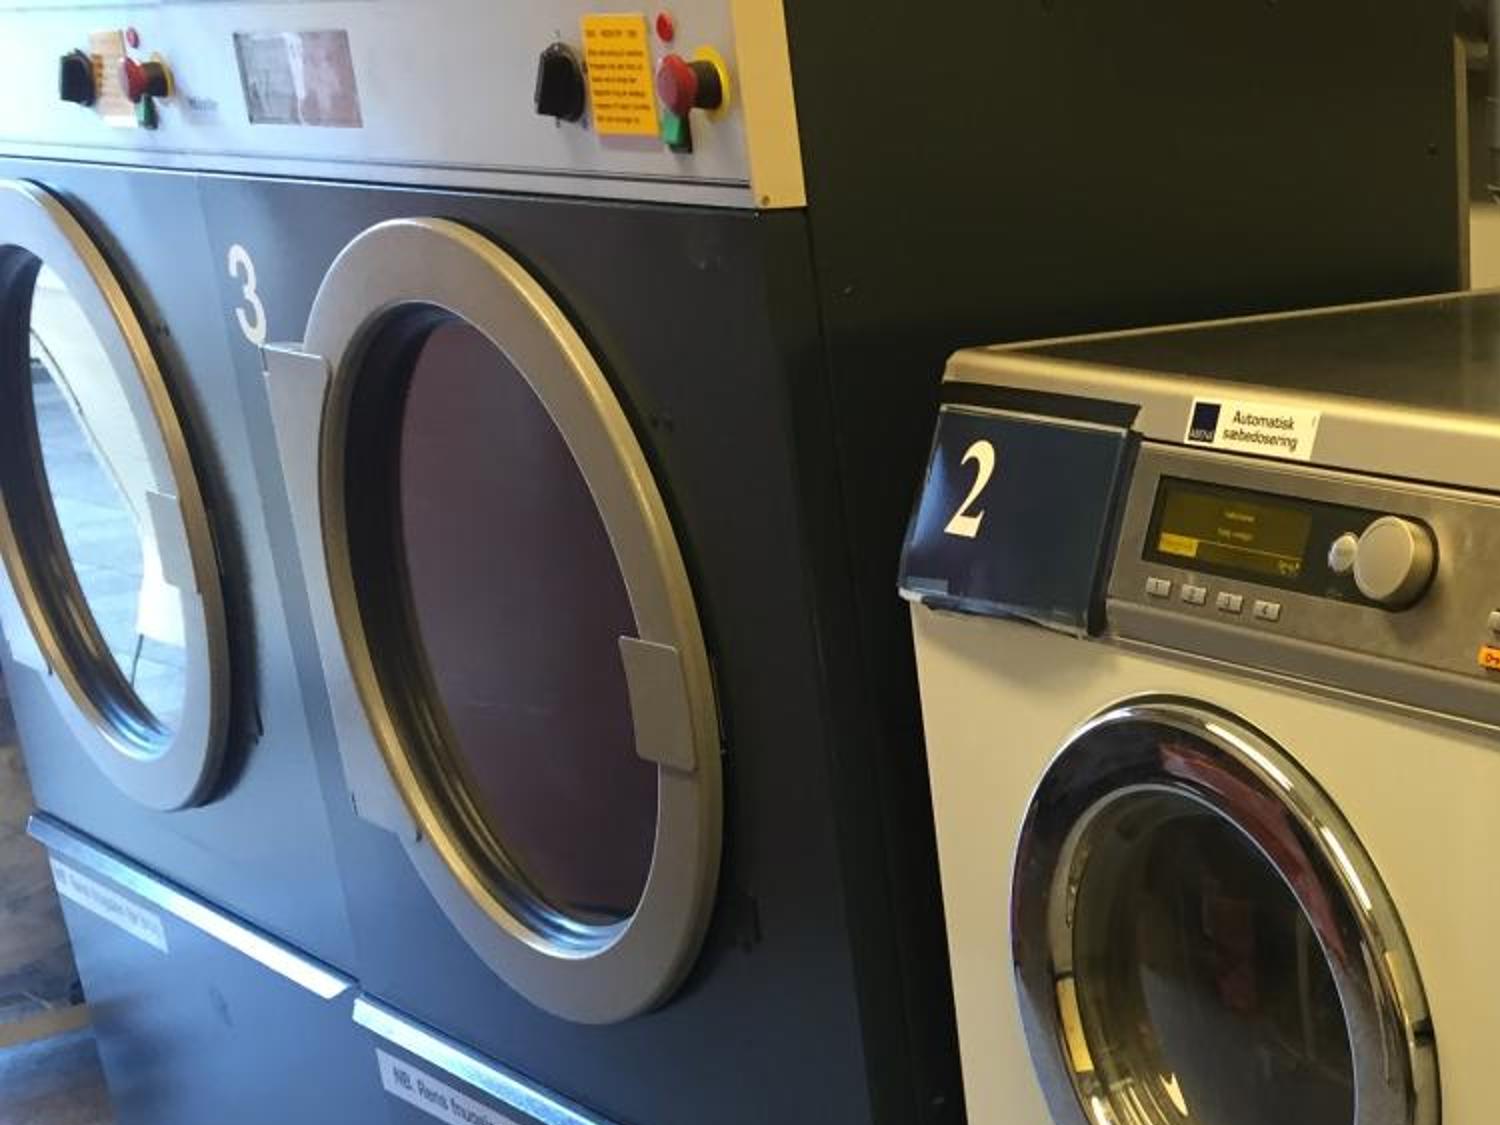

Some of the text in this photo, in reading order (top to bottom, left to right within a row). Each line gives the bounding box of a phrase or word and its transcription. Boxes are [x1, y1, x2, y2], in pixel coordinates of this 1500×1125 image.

[228, 243, 267, 346] 3
[1233, 411, 1295, 431] Automatisk
[943, 439, 996, 539] 2
